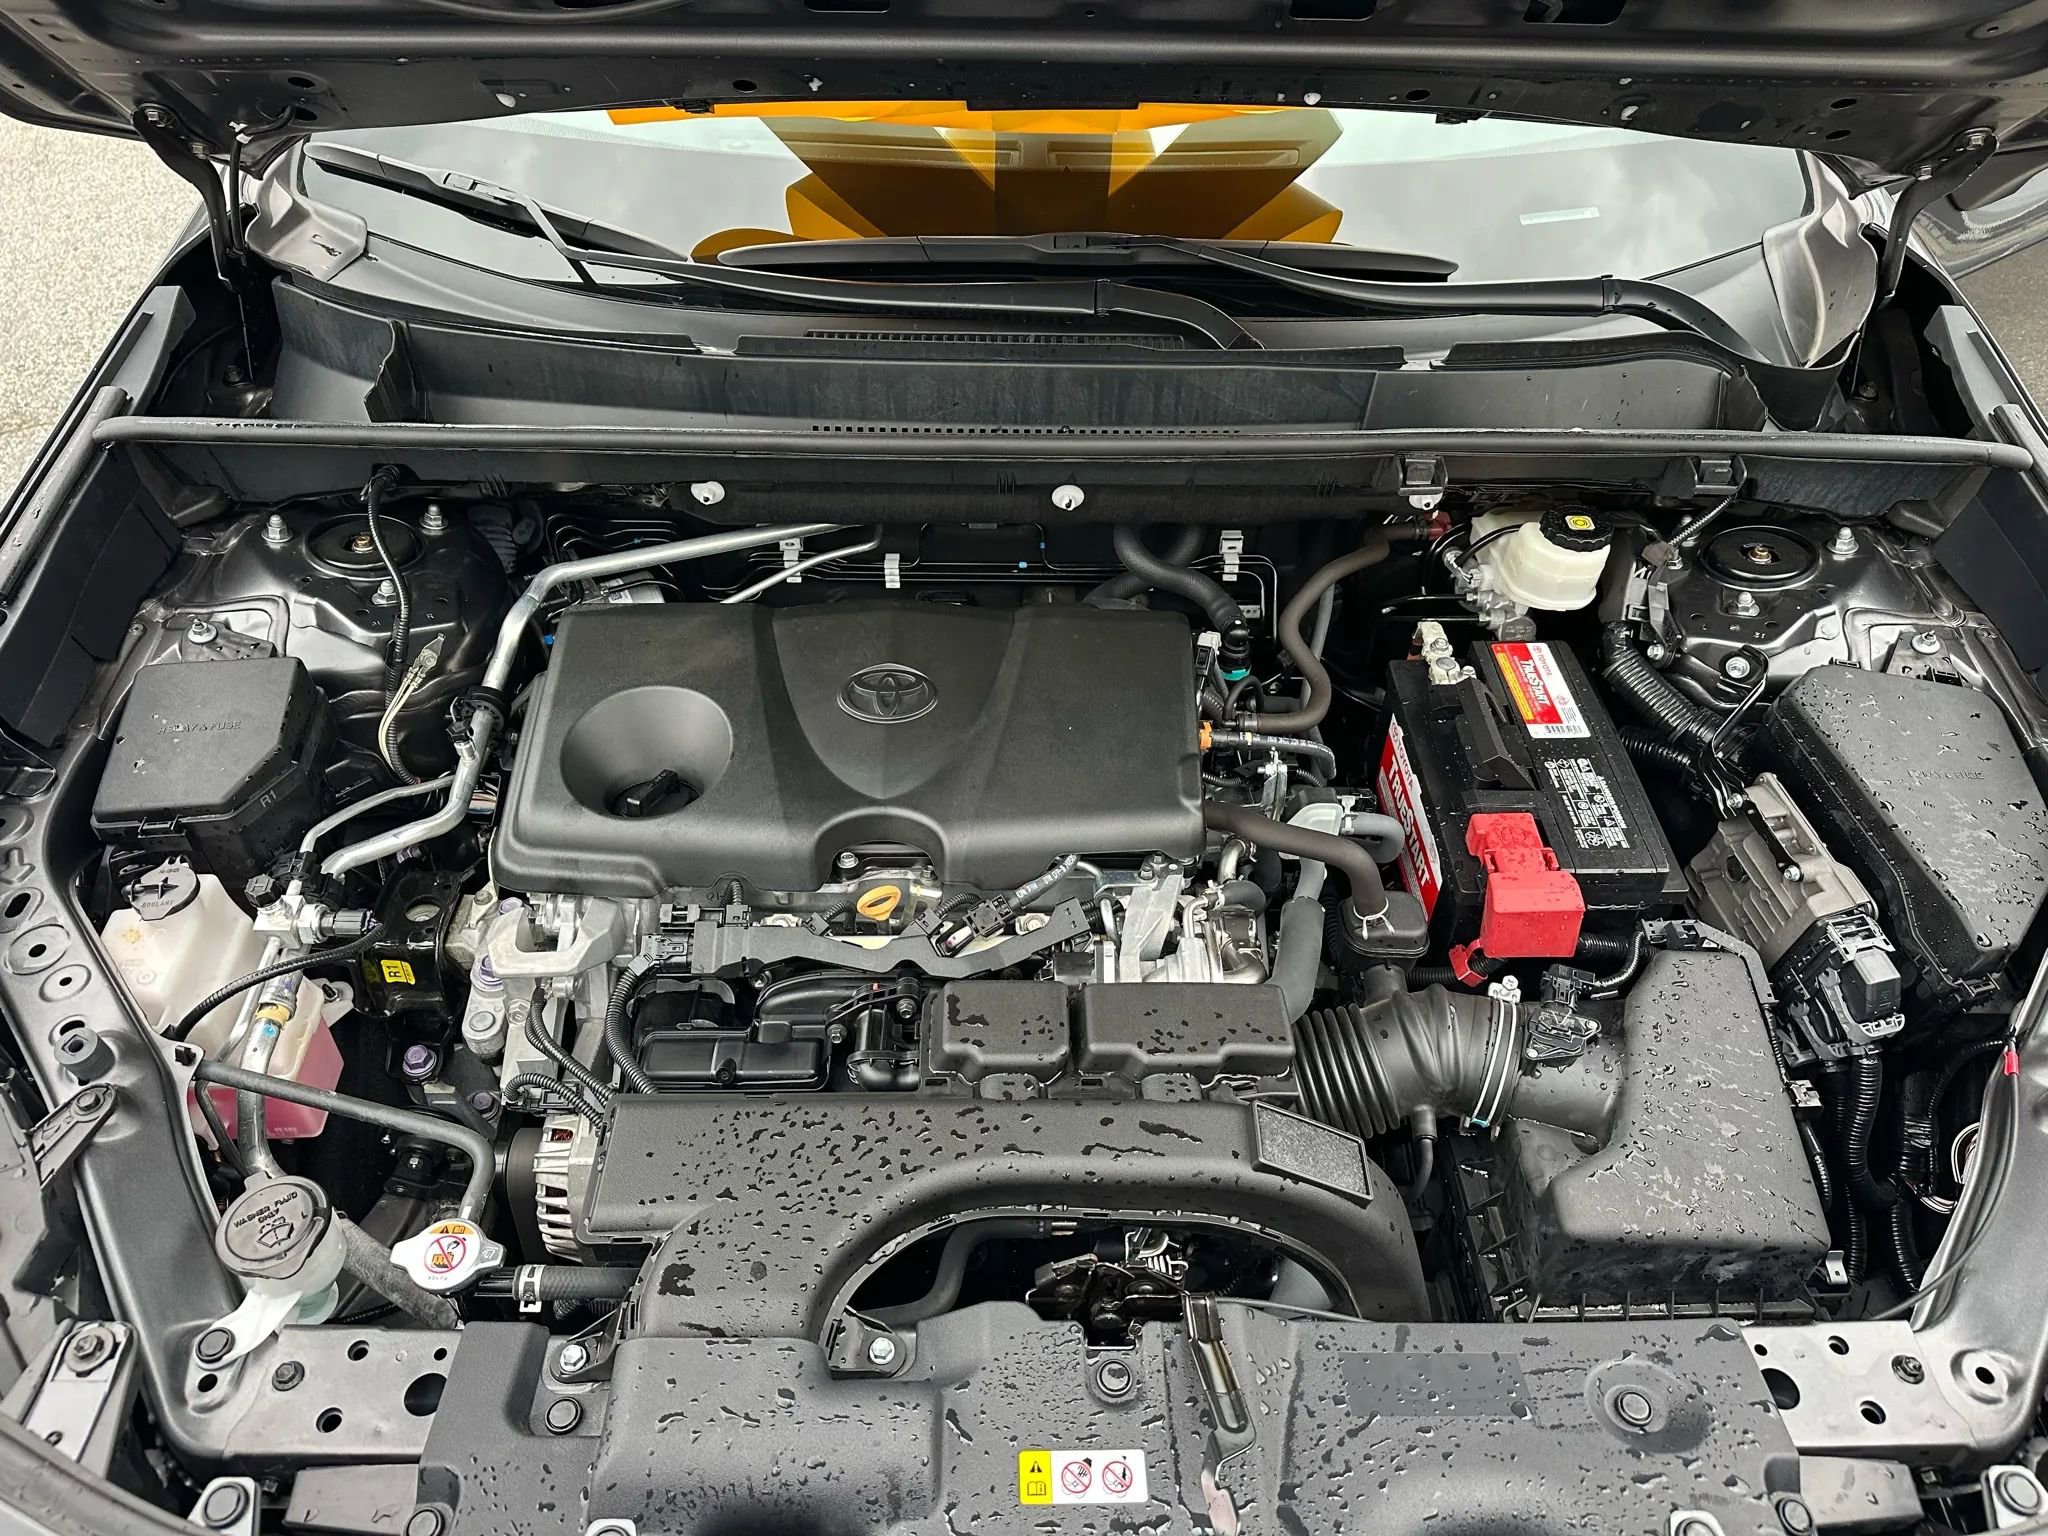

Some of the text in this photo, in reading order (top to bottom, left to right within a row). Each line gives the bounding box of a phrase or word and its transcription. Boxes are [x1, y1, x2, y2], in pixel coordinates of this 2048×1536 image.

[1538, 653, 1553, 677] TOYOTA
[210, 720, 242, 731] FUSE
[1397, 741, 1413, 792] TOYOTA
[260, 790, 277, 808] R1
[140, 899, 174, 909] COOLANT
[386, 965, 402, 978] R1
[233, 1191, 298, 1228] WASHER FLUID
[257, 1207, 280, 1223] ONLY
